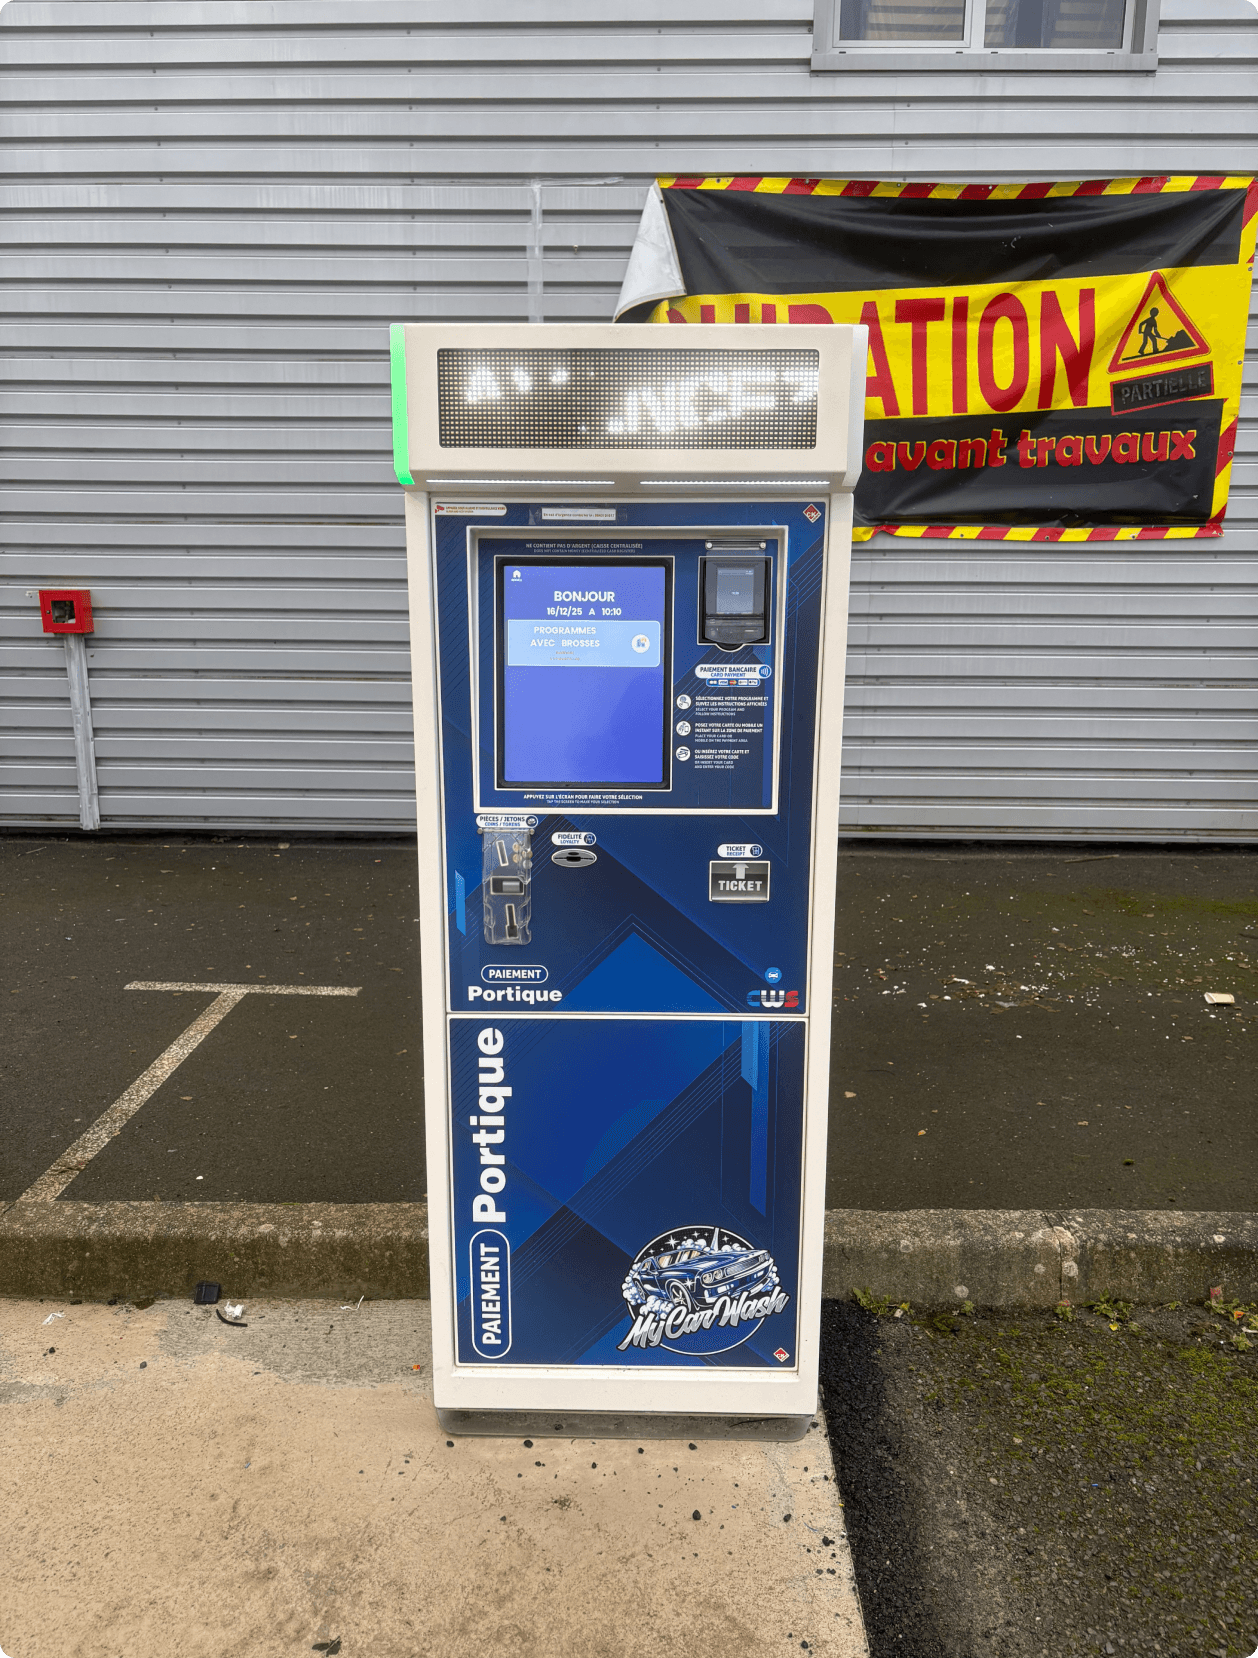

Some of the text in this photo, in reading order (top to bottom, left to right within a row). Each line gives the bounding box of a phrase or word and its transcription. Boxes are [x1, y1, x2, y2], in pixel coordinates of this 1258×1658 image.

[1120, 371, 1208, 405] PARTIELLE
[865, 428, 1198, 473] avant travaux
[554, 590, 615, 602] BONJOUR
[547, 606, 622, 617] 16/12/25 A 10:10
[534, 626, 596, 634] PROGRAMMES
[530, 639, 600, 647] AVEC BROSSES
[718, 880, 762, 891] TICKET
[488, 969, 542, 979] PAIEMENT
[468, 986, 562, 1004] Portique
[746, 990, 799, 1008] CWS
[470, 1027, 512, 1223] Portique
[480, 1243, 502, 1345] PAIEMENT
[617, 1286, 790, 1350] My Car Wash
